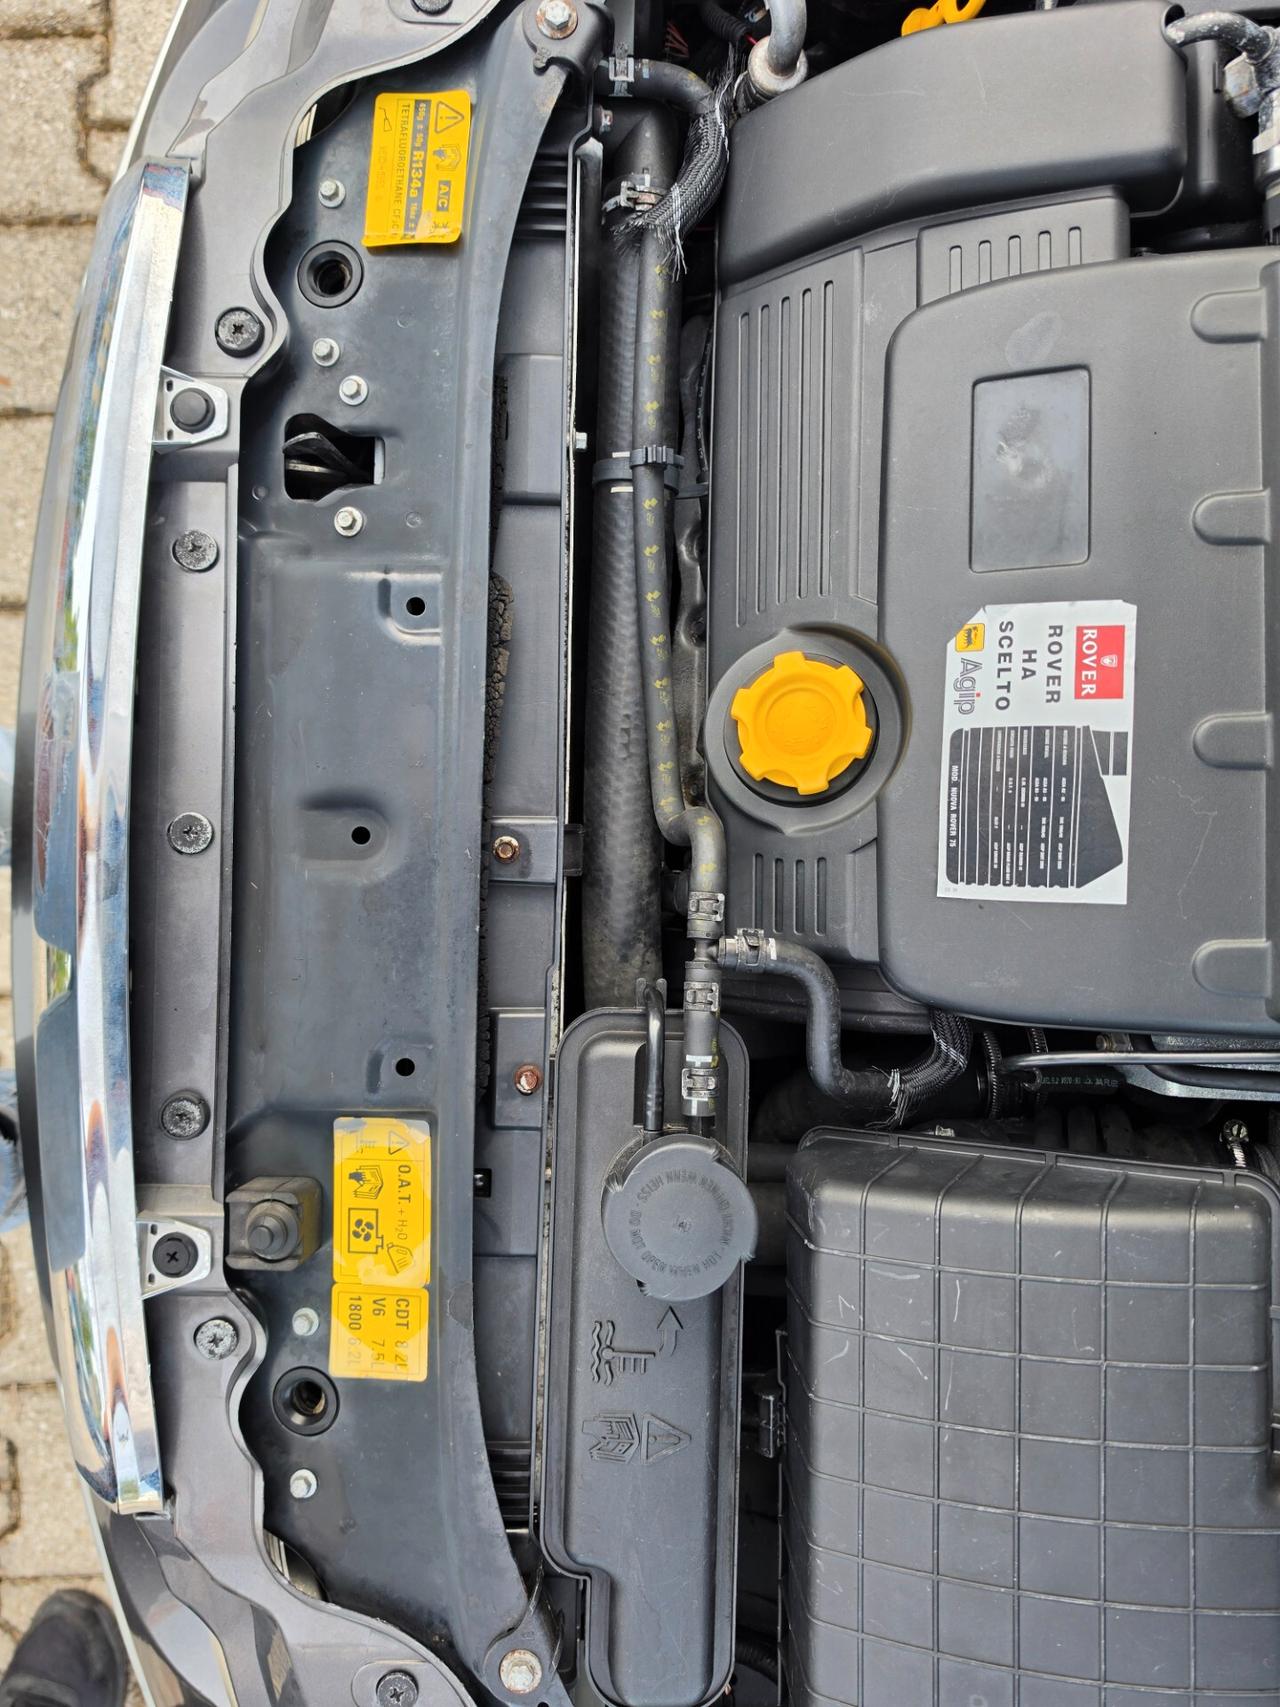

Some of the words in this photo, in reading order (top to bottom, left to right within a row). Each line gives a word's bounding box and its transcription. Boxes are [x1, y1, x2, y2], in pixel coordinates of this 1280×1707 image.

[394, 103, 410, 204] TETRAFLUOROETHANE
[410, 150, 424, 198] R134a
[438, 183, 449, 208] A/C
[995, 620, 1014, 712] SCELTO
[1021, 649, 1038, 680] HA
[1045, 624, 1064, 704] ROVER
[1080, 628, 1098, 696] ROVER
[953, 658, 983, 716] Agip
[950, 765, 959, 784] MOD.
[949, 787, 958, 810] NUOVA
[949, 813, 957, 836] ROVER
[948, 839, 956, 848] 75
[397, 1164, 411, 1205] O.A.T.
[637, 1175, 664, 1204] HEISS
[630, 1229, 646, 1250] NOT
[701, 1250, 722, 1271] HOT
[348, 1295, 362, 1330] 1800
[372, 1298, 385, 1316] V6
[395, 1298, 410, 1330] CDT
[394, 1340, 409, 1370] 82L
